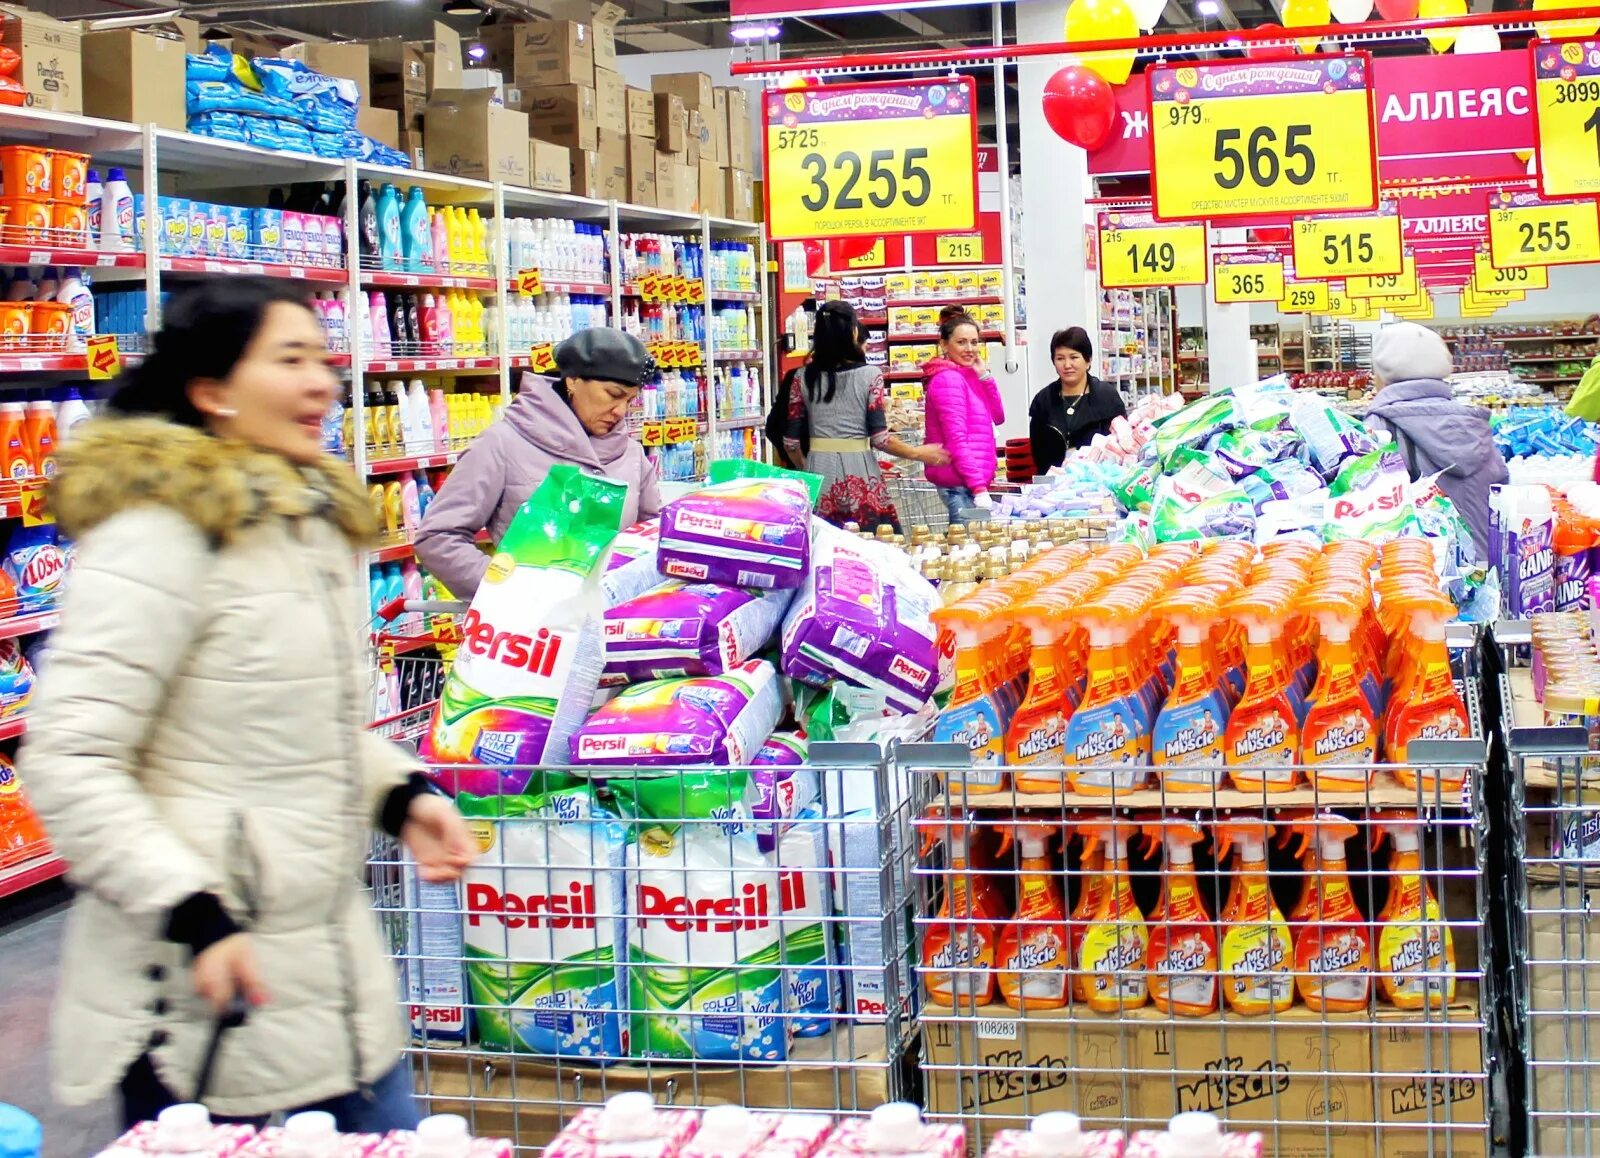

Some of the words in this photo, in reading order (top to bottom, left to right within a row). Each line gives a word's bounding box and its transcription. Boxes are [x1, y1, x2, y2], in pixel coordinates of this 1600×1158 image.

[1249, 67, 1321, 84] рождения!
[854, 92, 920, 108] рождения!
[1556, 82, 1600, 103] 3099
[1170, 105, 1201, 126] 979
[778, 129, 819, 149] 5725
[1214, 125, 1315, 189] 565
[801, 148, 931, 212] 3255
[1497, 211, 1513, 222] 397
[1106, 233, 1122, 243] 215
[1301, 223, 1317, 234] 977
[1519, 221, 1571, 253] 255
[949, 244, 971, 258] 215
[1127, 242, 1175, 273] 149
[1324, 233, 1373, 265] 515
[1231, 274, 1264, 294] 365
[1291, 290, 1315, 306] 259
[679, 512, 723, 530] Persil
[27, 555, 63, 585] LOSK
[1520, 548, 1554, 580] BANG
[1557, 580, 1584, 606] ANG
[605, 621, 625, 635] rsil
[463, 608, 562, 679] Persil
[893, 657, 929, 683] Persil
[484, 732, 516, 744] COLD
[953, 730, 968, 743] Mr
[1030, 729, 1047, 742] Mr
[1087, 732, 1104, 744] Mr
[1178, 729, 1195, 741] Mr
[1247, 727, 1263, 742] Mr
[1316, 728, 1365, 755] Muscle
[1328, 726, 1344, 740] Mr
[1422, 725, 1438, 738] Mr
[582, 737, 626, 751] Persil
[1018, 732, 1065, 757] Muscle
[1076, 735, 1125, 761] Muscle
[1165, 730, 1214, 758] Muscle
[1236, 730, 1283, 757] Muscle
[552, 795, 576, 813] Ver
[467, 881, 596, 929] Persil
[636, 883, 769, 932] Persil
[933, 945, 980, 968] Muscle
[1020, 945, 1036, 957] Mr
[1170, 950, 1185, 961] Mr
[1246, 947, 1263, 961] Mr
[1322, 948, 1339, 960] Mr
[1391, 941, 1441, 970] Muscle
[1403, 941, 1422, 954] Mr
[1008, 946, 1056, 971] Muscle
[1095, 948, 1142, 974] Muscle
[1157, 952, 1205, 974] Muscle
[1233, 949, 1283, 977] Muscle
[1310, 949, 1360, 974] Muscle
[790, 981, 810, 996] Ver
[410, 1004, 461, 1022] Persil
[703, 996, 736, 1009] COLD
[979, 1021, 1015, 1035] 108283
[986, 1050, 1022, 1074] Mr
[1205, 1056, 1243, 1080] Mr
[961, 1055, 1067, 1110] Muscle
[1177, 1060, 1290, 1113] Muscle
[1392, 1074, 1476, 1114] Muscle
